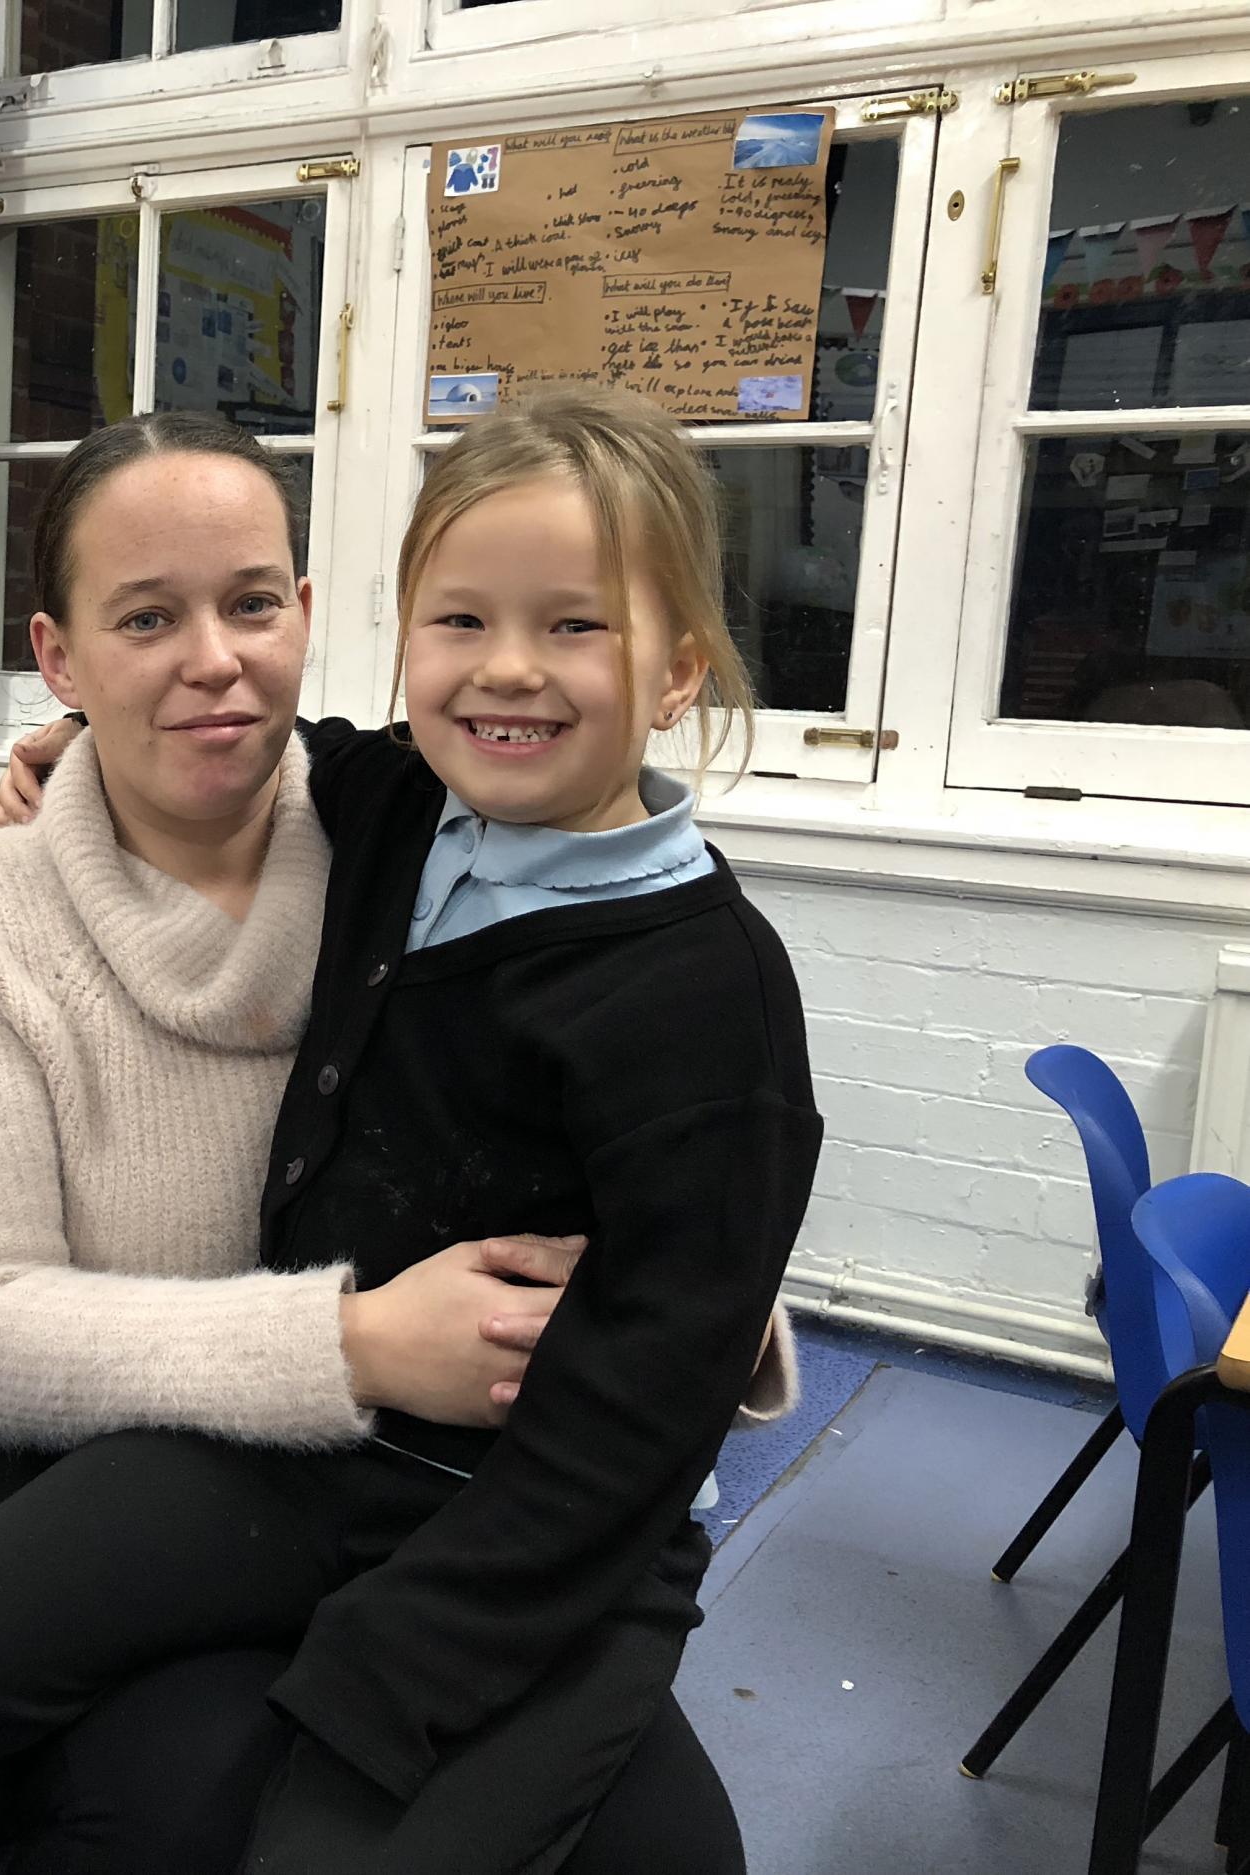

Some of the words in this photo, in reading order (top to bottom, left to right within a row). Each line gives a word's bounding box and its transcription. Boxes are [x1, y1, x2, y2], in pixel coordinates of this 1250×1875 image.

[621, 157, 649, 173] cold
[724, 173, 745, 189] It
[659, 280, 681, 295] you
[686, 274, 702, 287] do
